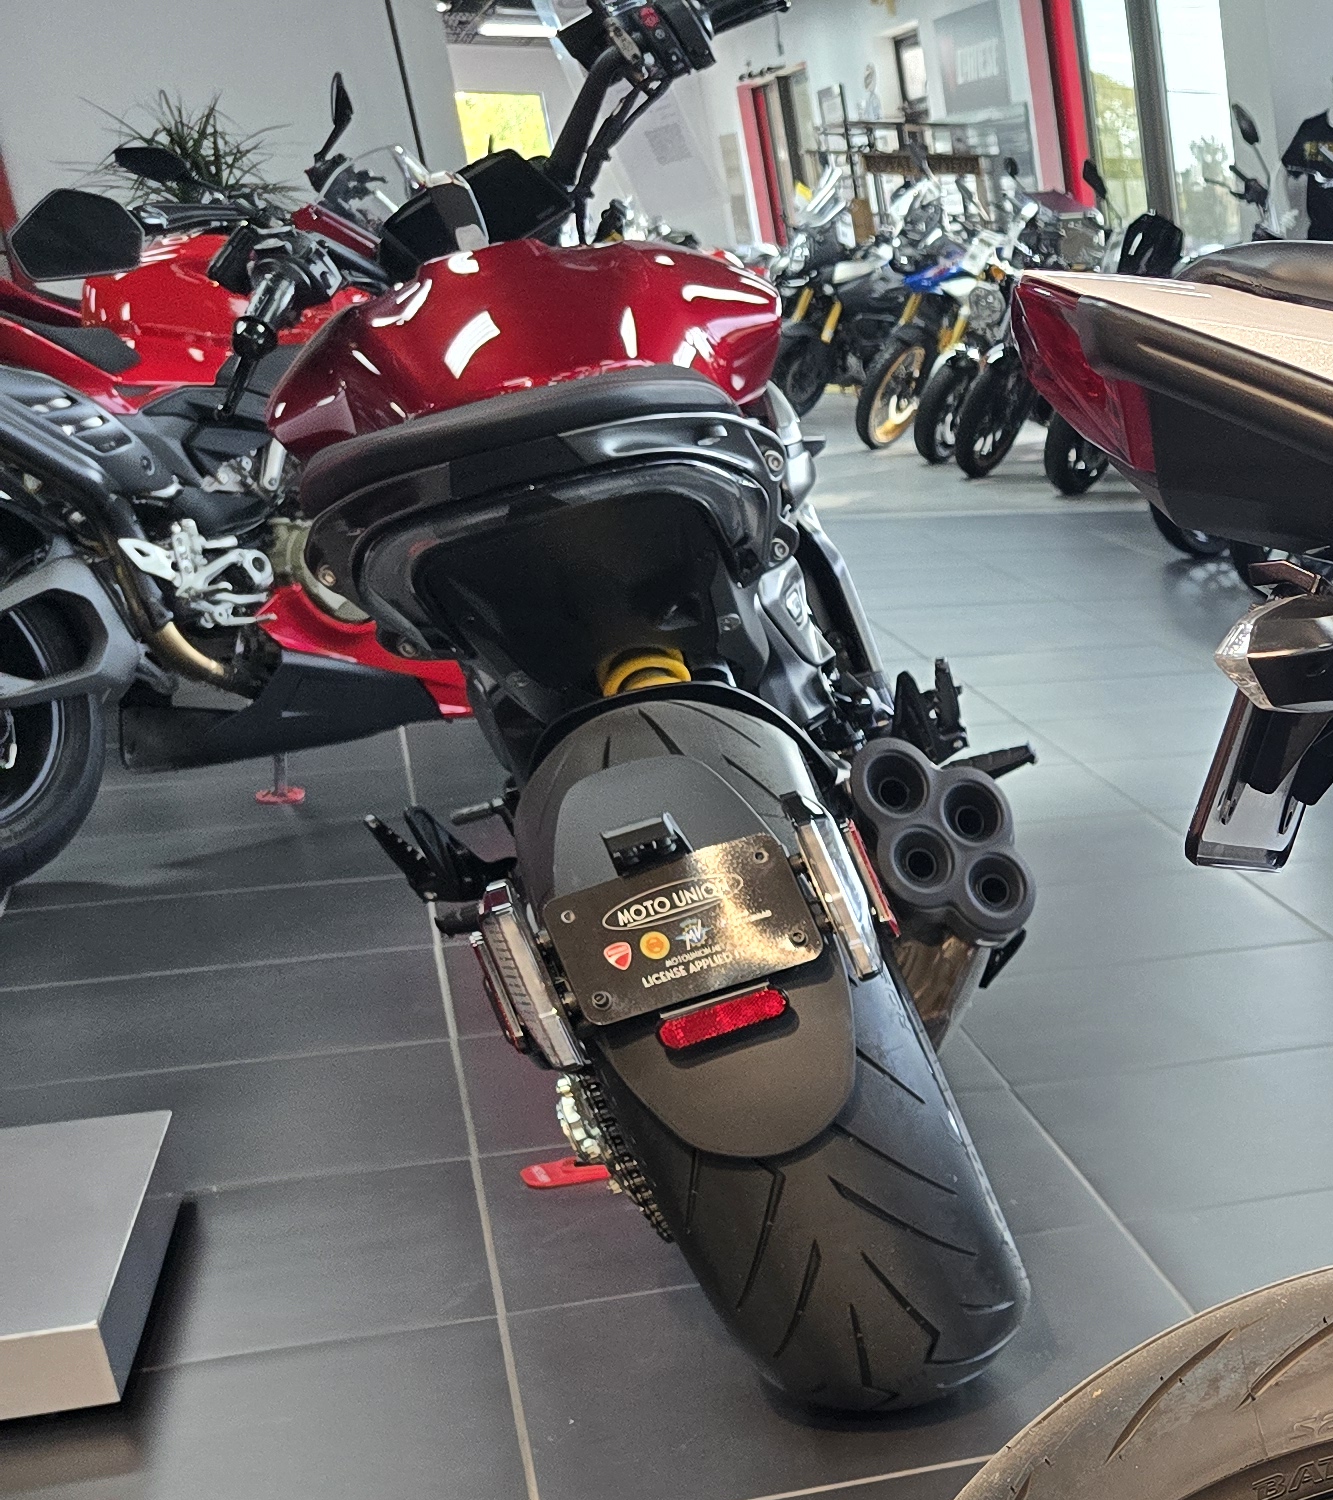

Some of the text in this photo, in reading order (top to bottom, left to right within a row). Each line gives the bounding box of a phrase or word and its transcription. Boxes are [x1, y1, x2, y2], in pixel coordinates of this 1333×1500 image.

[617, 877, 731, 927] MOTO UNION
[642, 965, 688, 989] LICENSE
[689, 951, 733, 975] APPLIED
